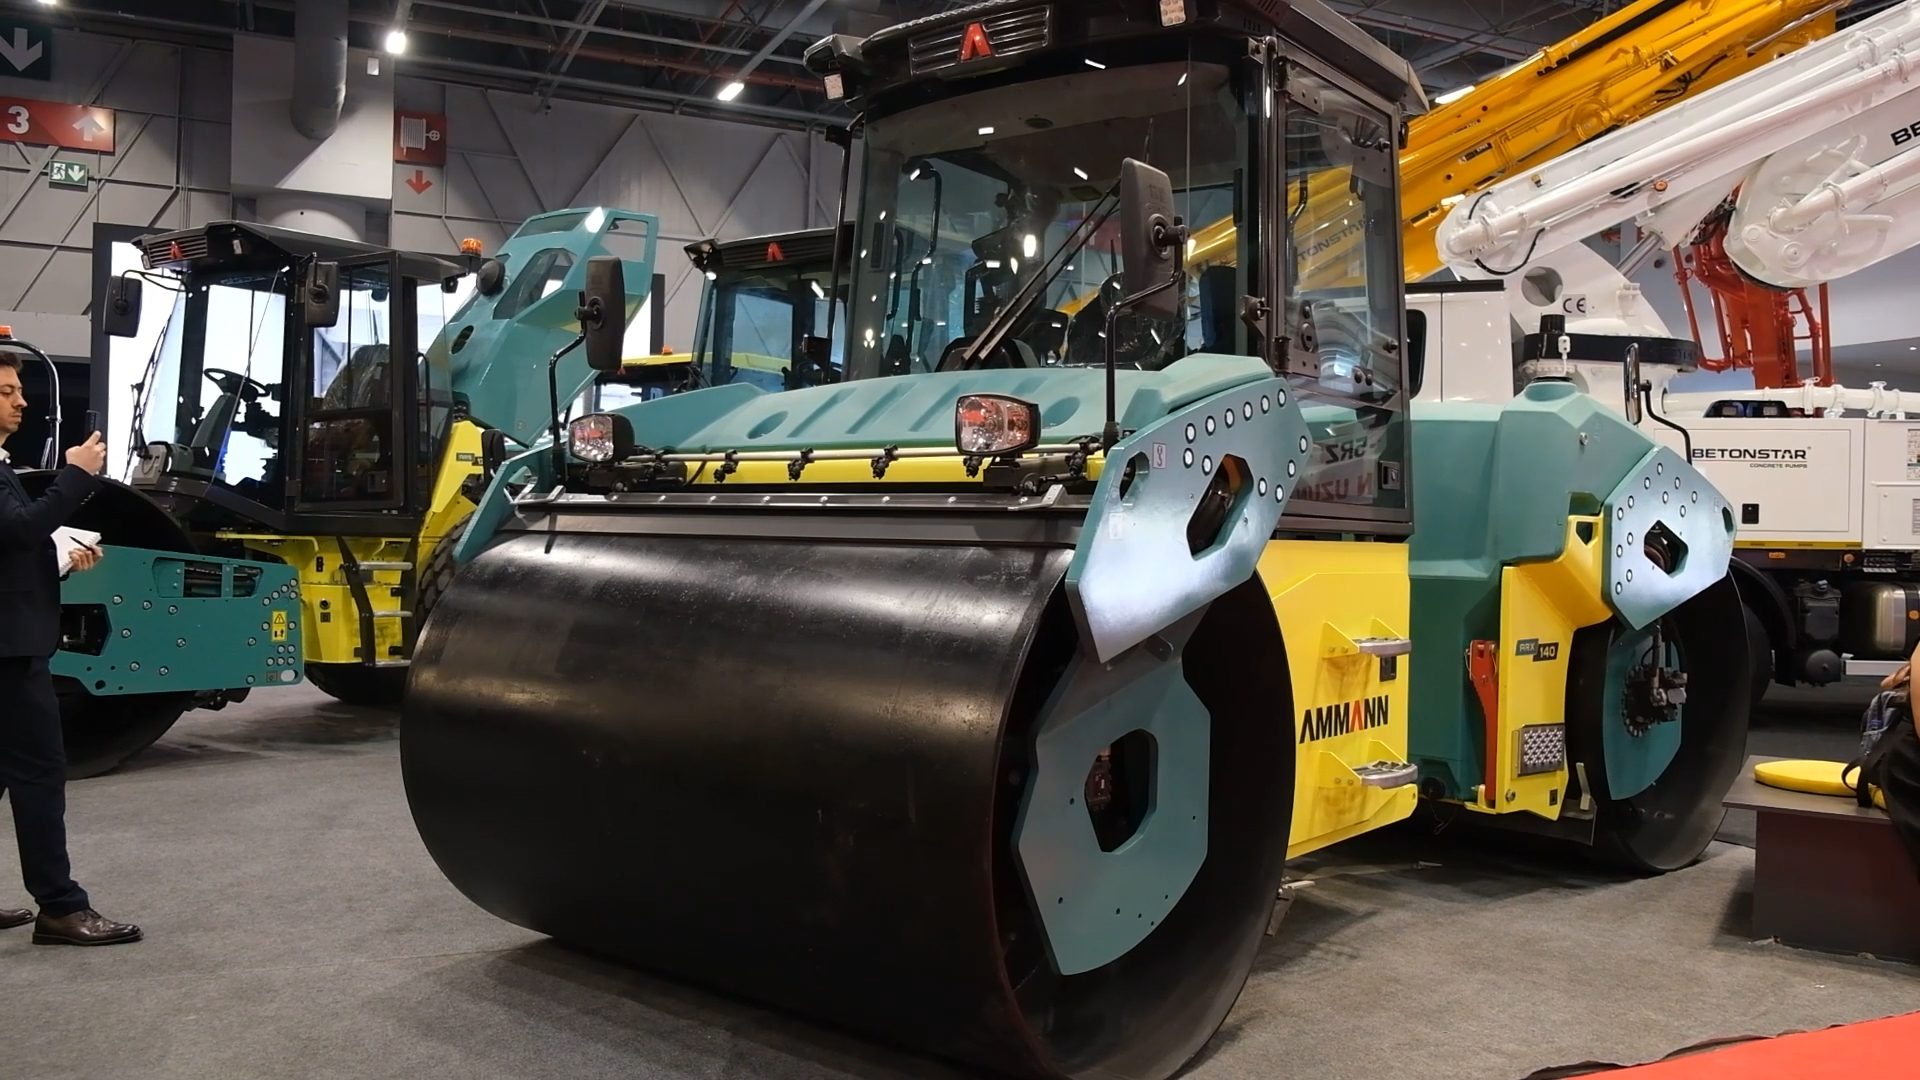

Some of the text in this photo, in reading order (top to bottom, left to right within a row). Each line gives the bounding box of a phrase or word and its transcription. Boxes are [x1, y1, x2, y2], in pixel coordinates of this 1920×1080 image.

[7, 105, 29, 134] 3
[1562, 297, 1586, 314] CE
[1691, 448, 1807, 460] BETONSTAR
[1540, 646, 1557, 659] 140
[1299, 694, 1389, 745] AMMANN
